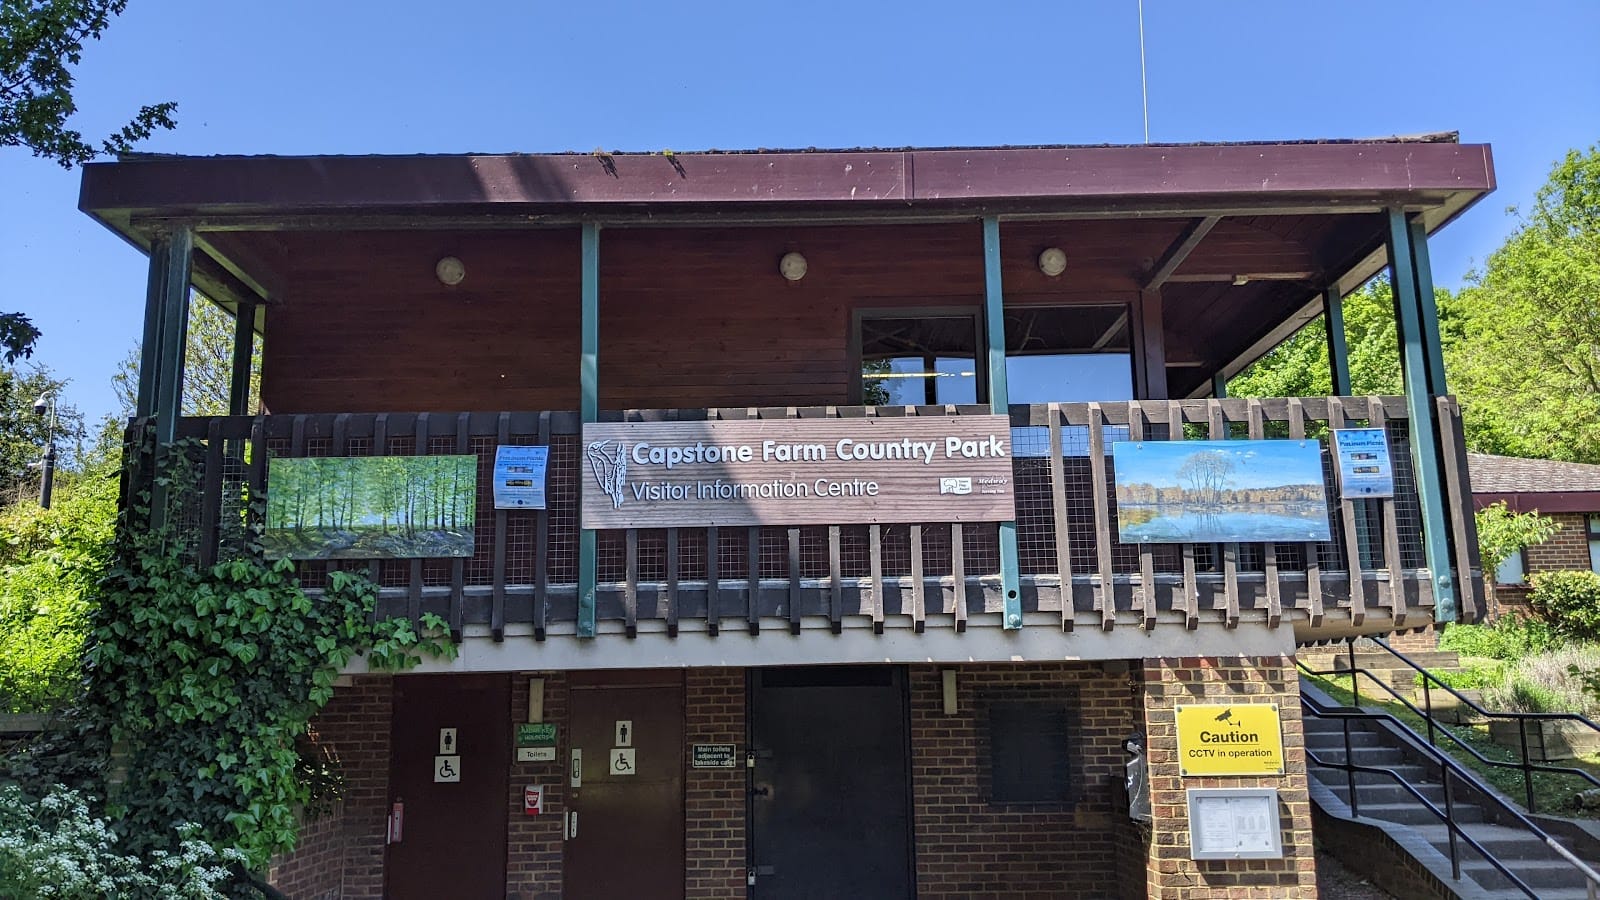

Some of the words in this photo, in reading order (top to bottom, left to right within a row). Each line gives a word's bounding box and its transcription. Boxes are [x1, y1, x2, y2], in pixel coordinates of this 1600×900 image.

[631, 441, 753, 469] Capstone
[762, 440, 827, 462] Farm
[836, 438, 936, 464] Country
[945, 434, 1006, 458] Park
[977, 476, 1008, 487] Medway
[631, 481, 692, 500] Visitor
[697, 479, 808, 500] Information
[814, 478, 879, 497] Centre
[1200, 731, 1258, 743] Caution
[1188, 749, 1215, 758] CCTV
[1218, 749, 1226, 757] in
[1228, 748, 1272, 759] operation
